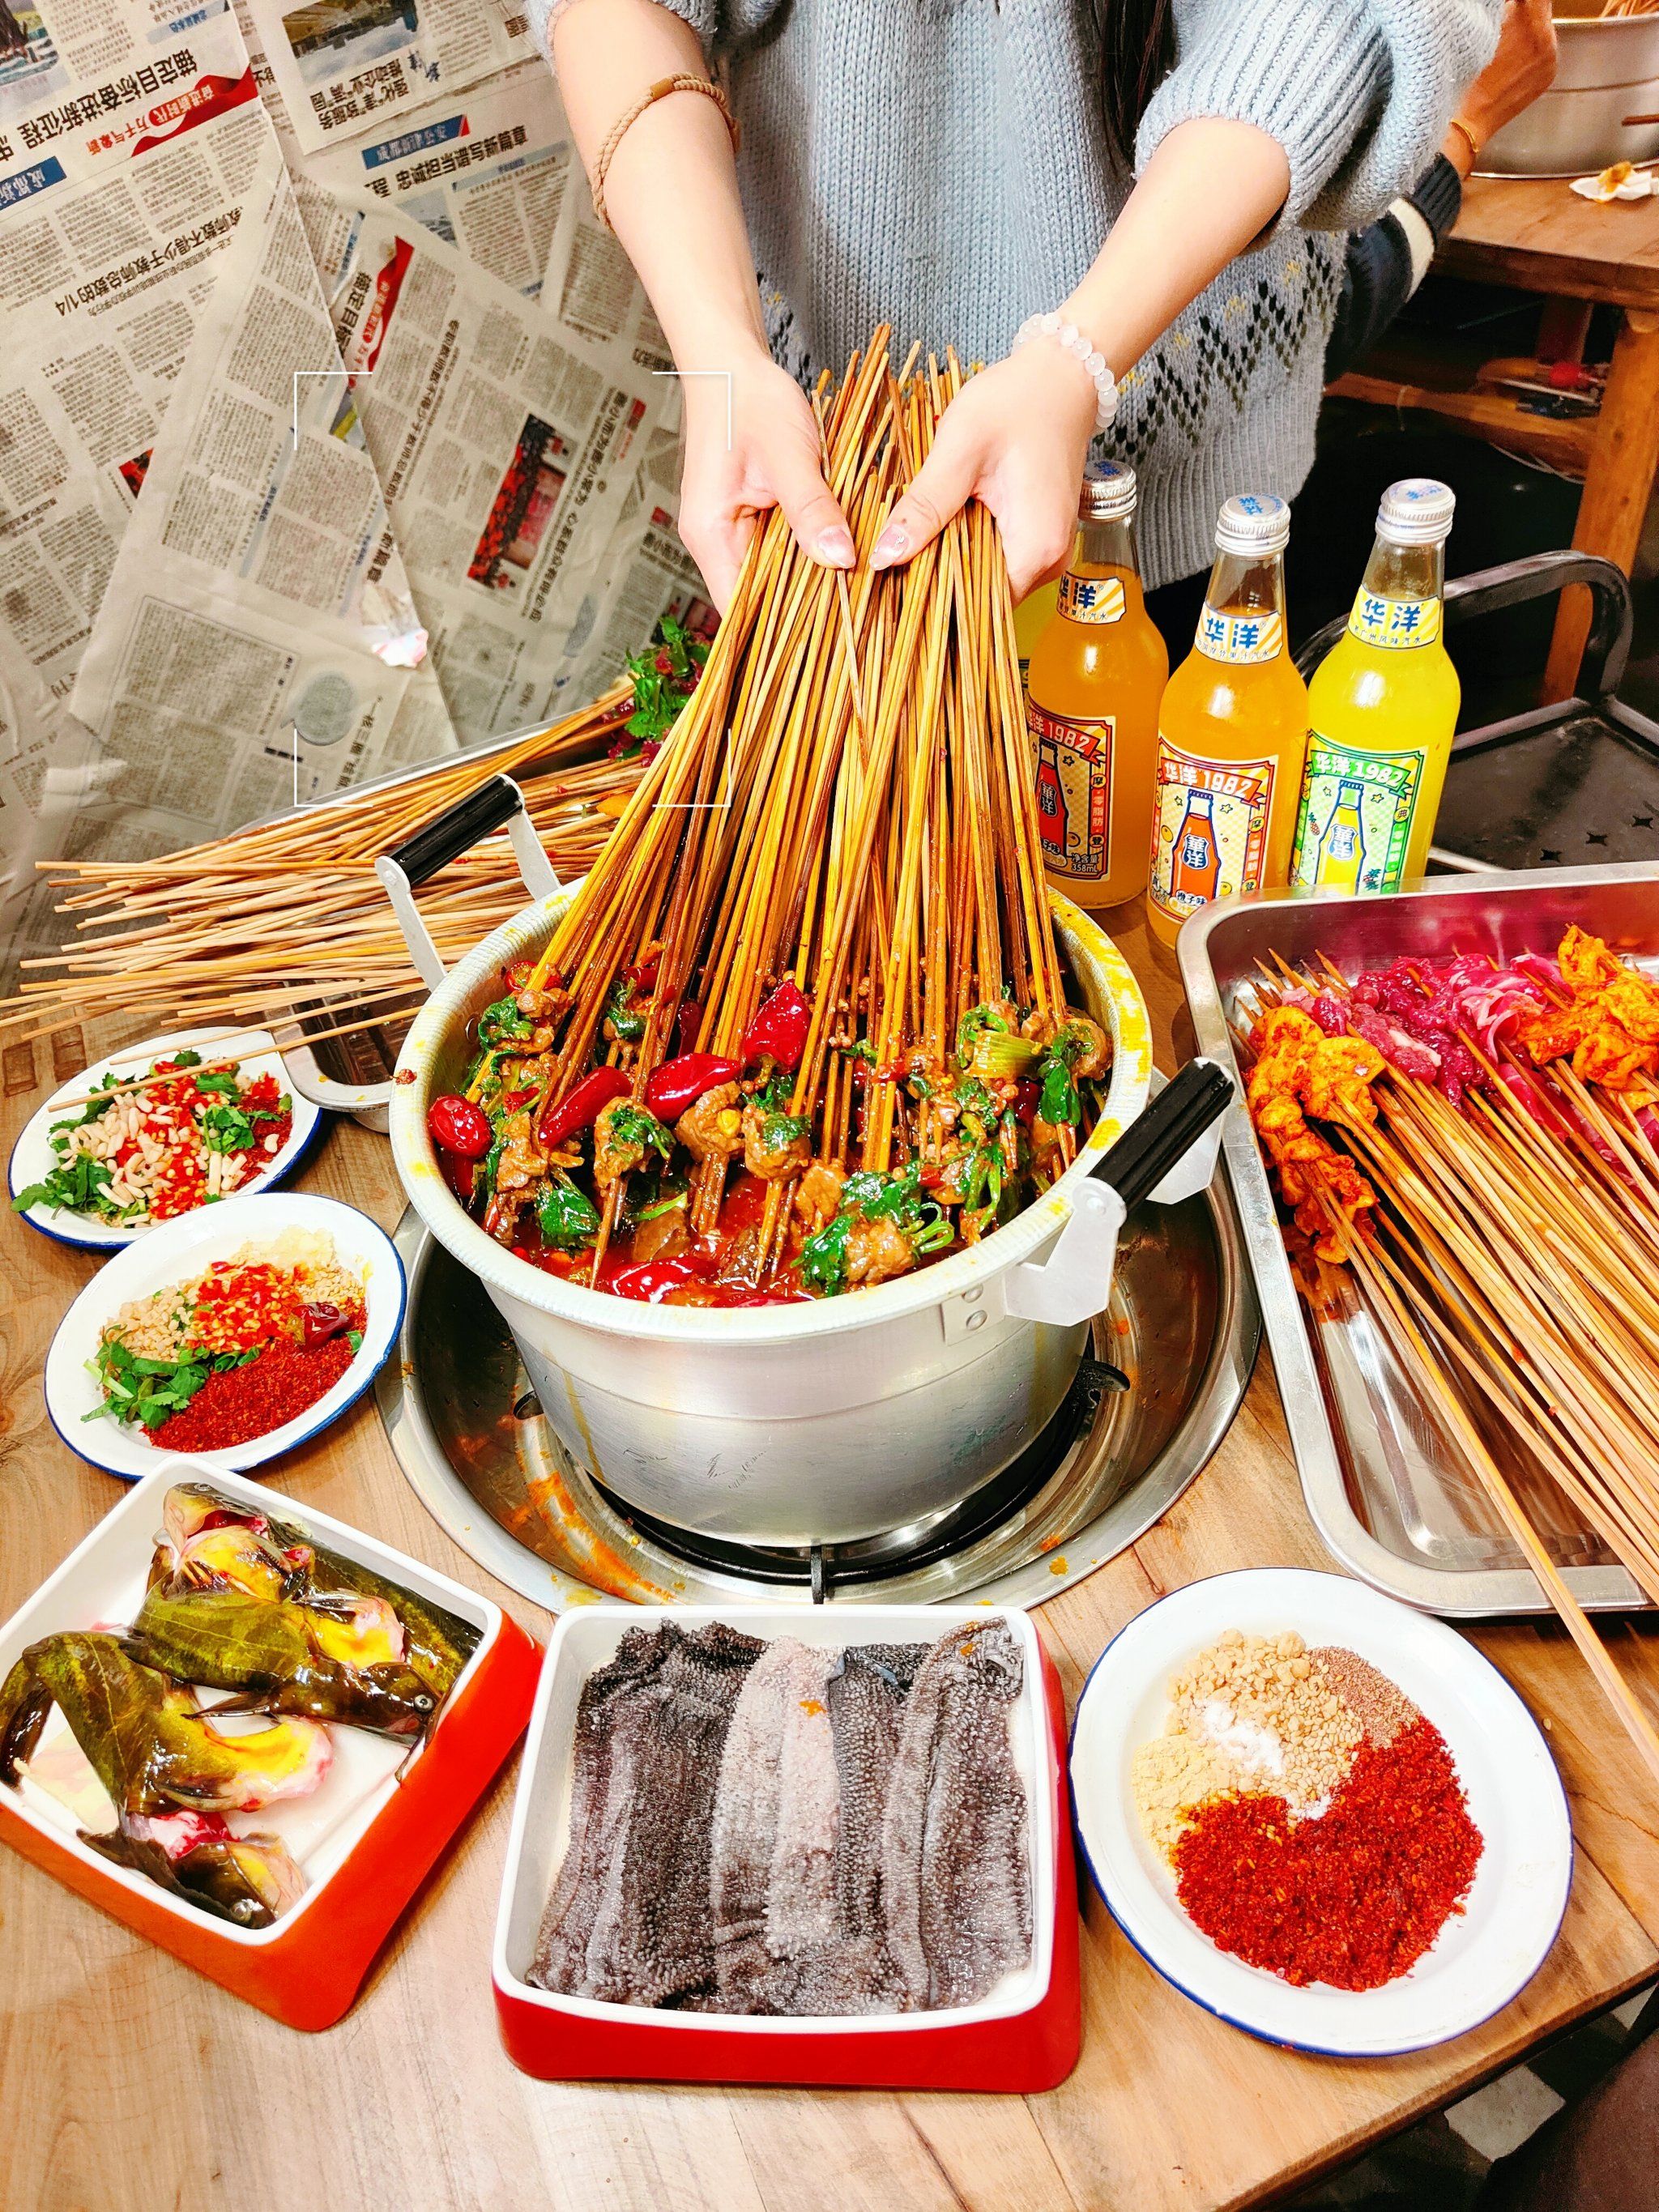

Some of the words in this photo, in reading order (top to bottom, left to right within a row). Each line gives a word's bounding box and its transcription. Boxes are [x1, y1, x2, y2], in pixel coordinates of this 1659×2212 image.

[16, 49, 198, 150] 锚定目标奋进新征程
[150, 84, 215, 125] 奋进新时代
[85, 116, 151, 156] 万千气象新
[394, 125, 529, 191] 忠诚担当谱写新篇章
[1205, 617, 1259, 649] 华洋
[1362, 599, 1421, 633] 华洋
[1047, 721, 1090, 754] 1982
[1163, 761, 1198, 786] 华洋
[1202, 769, 1252, 797] 1982
[1315, 752, 1351, 776] 华洋
[1352, 760, 1405, 787] 1982
[1186, 836, 1207, 868] 華洋
